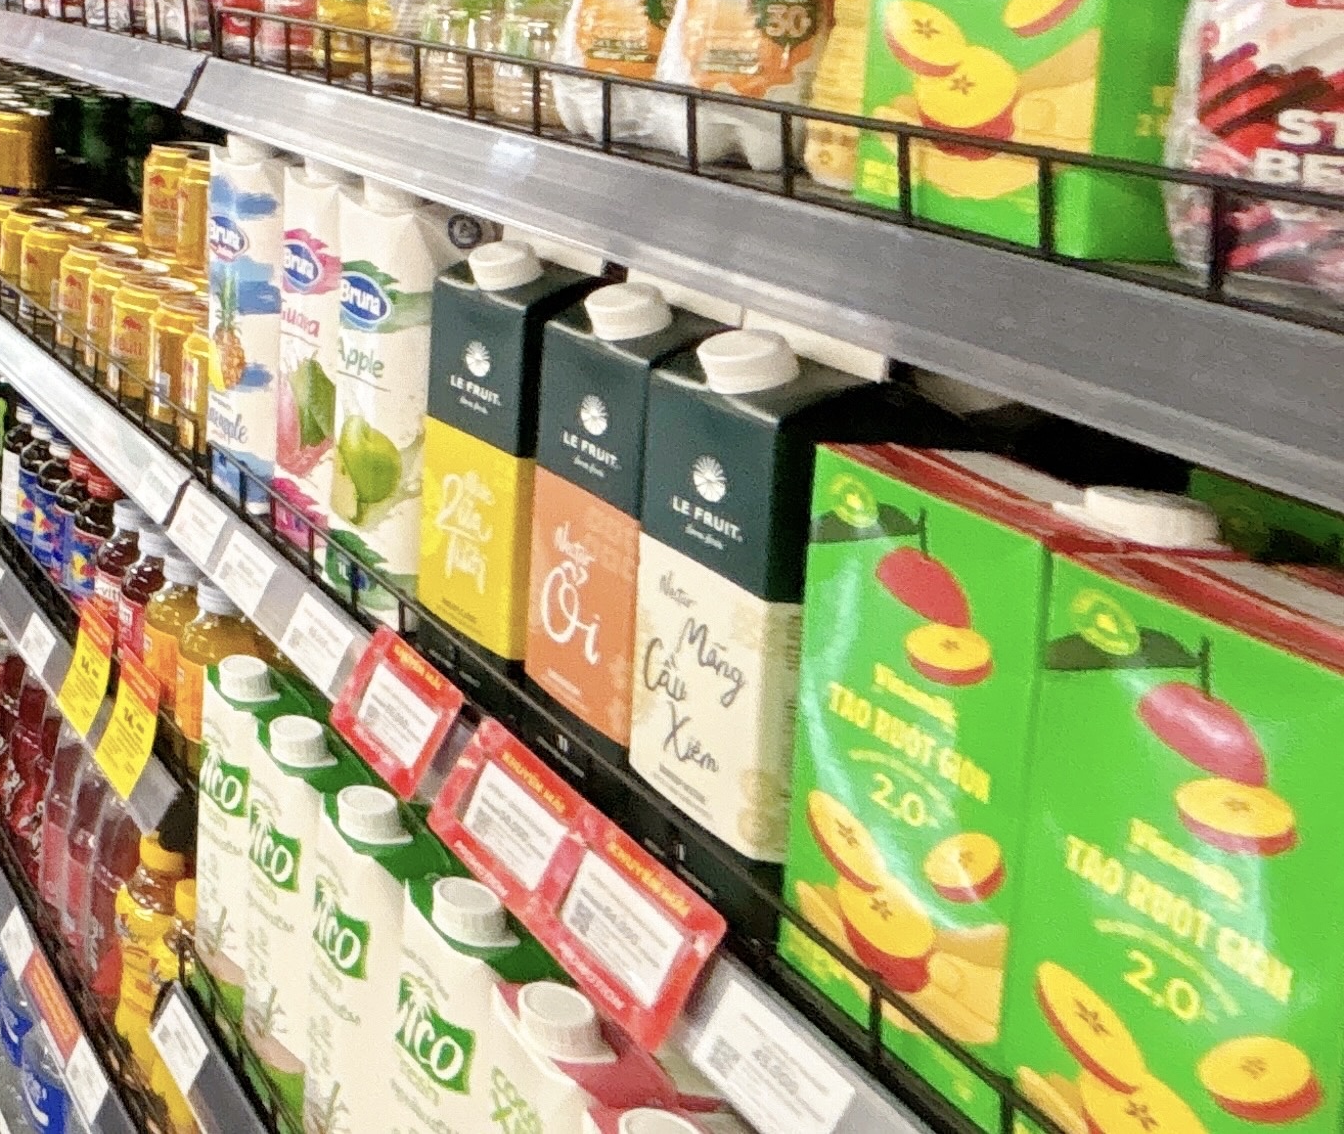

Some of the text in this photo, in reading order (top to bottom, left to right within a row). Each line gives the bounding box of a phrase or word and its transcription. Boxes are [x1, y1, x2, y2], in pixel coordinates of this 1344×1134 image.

[340, 278, 382, 318] Bruna
[450, 372, 501, 406] LE FRUIT
[562, 430, 579, 450] LE
[580, 439, 619, 468] FRUIT
[671, 495, 691, 517] LE
[693, 505, 740, 541] FRUIT
[643, 637, 687, 703] Cầu
[676, 617, 745, 708] Mãng
[663, 700, 720, 774] Xiêm
[869, 772, 926, 828] 2.0
[1122, 947, 1202, 1022] 2.0
